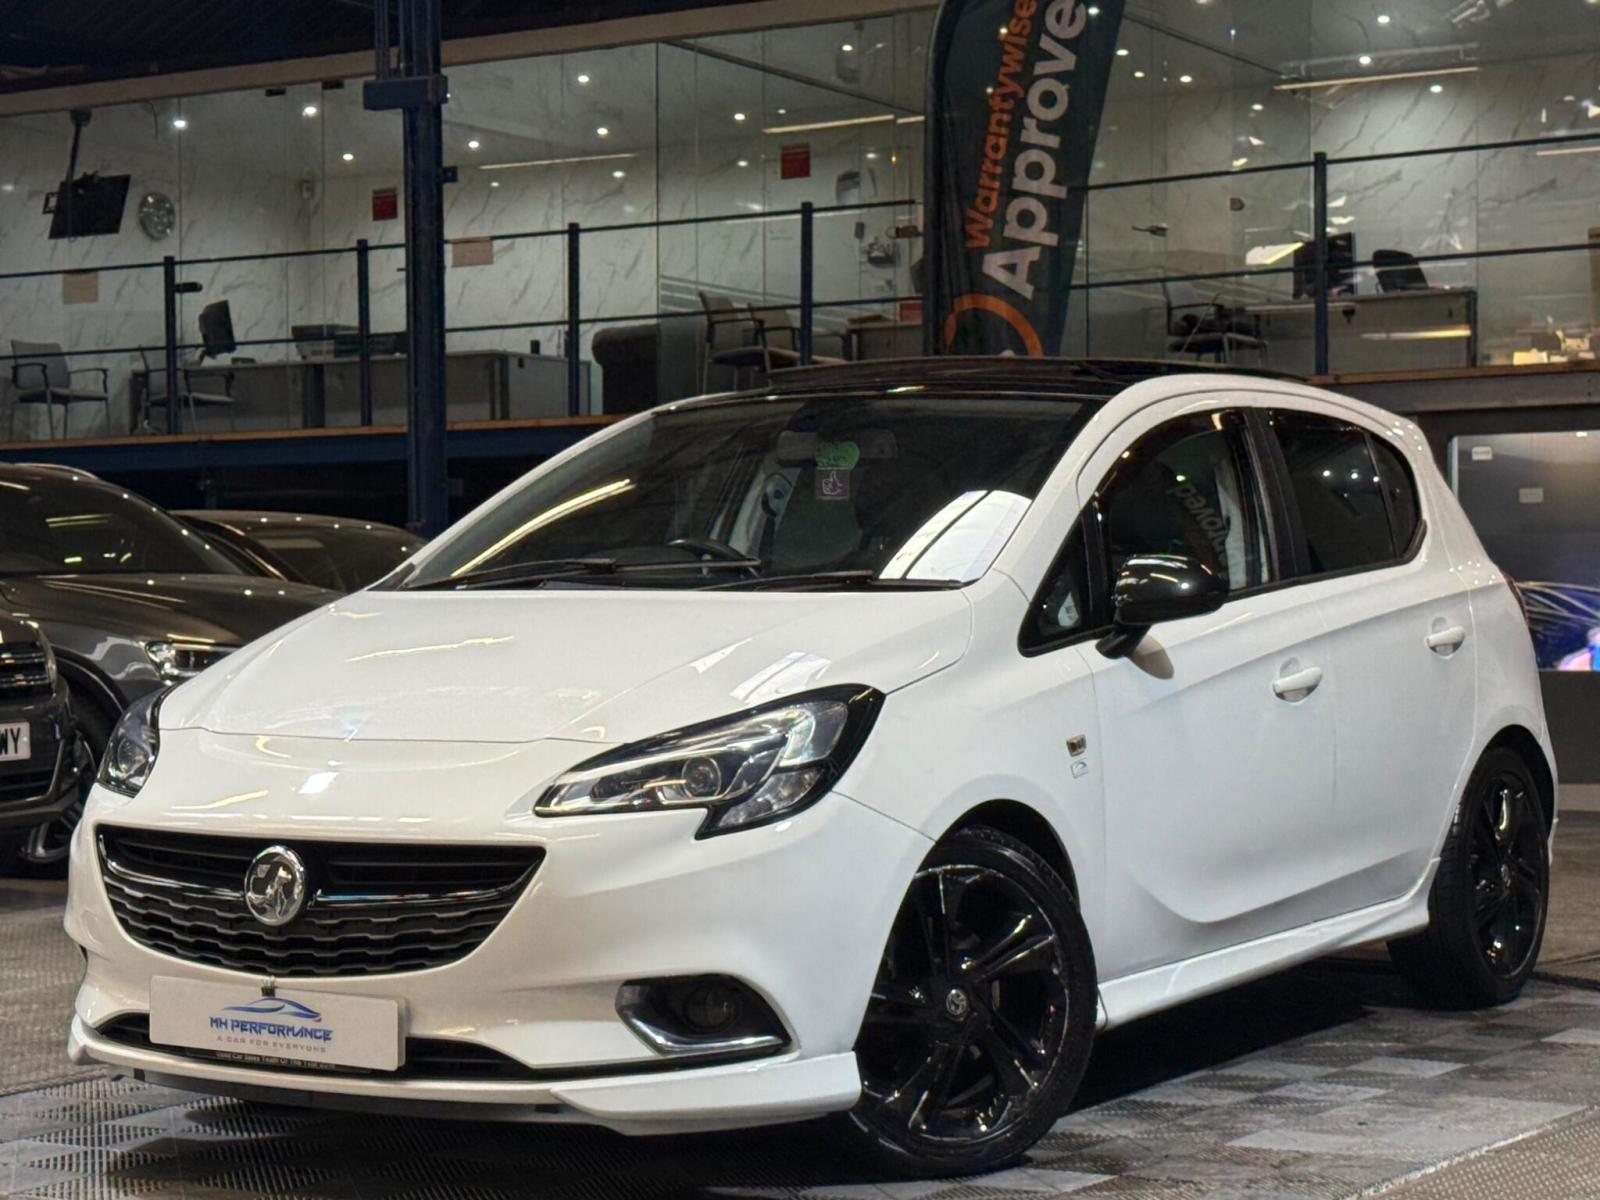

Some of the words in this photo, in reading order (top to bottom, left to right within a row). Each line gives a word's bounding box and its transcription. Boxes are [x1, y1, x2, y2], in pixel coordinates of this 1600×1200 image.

[964, 0, 1038, 248] Warrantywise
[209, 1016, 228, 1030] MH
[230, 1019, 334, 1042] PERFORMANCE
[227, 1036, 246, 1044] CAR
